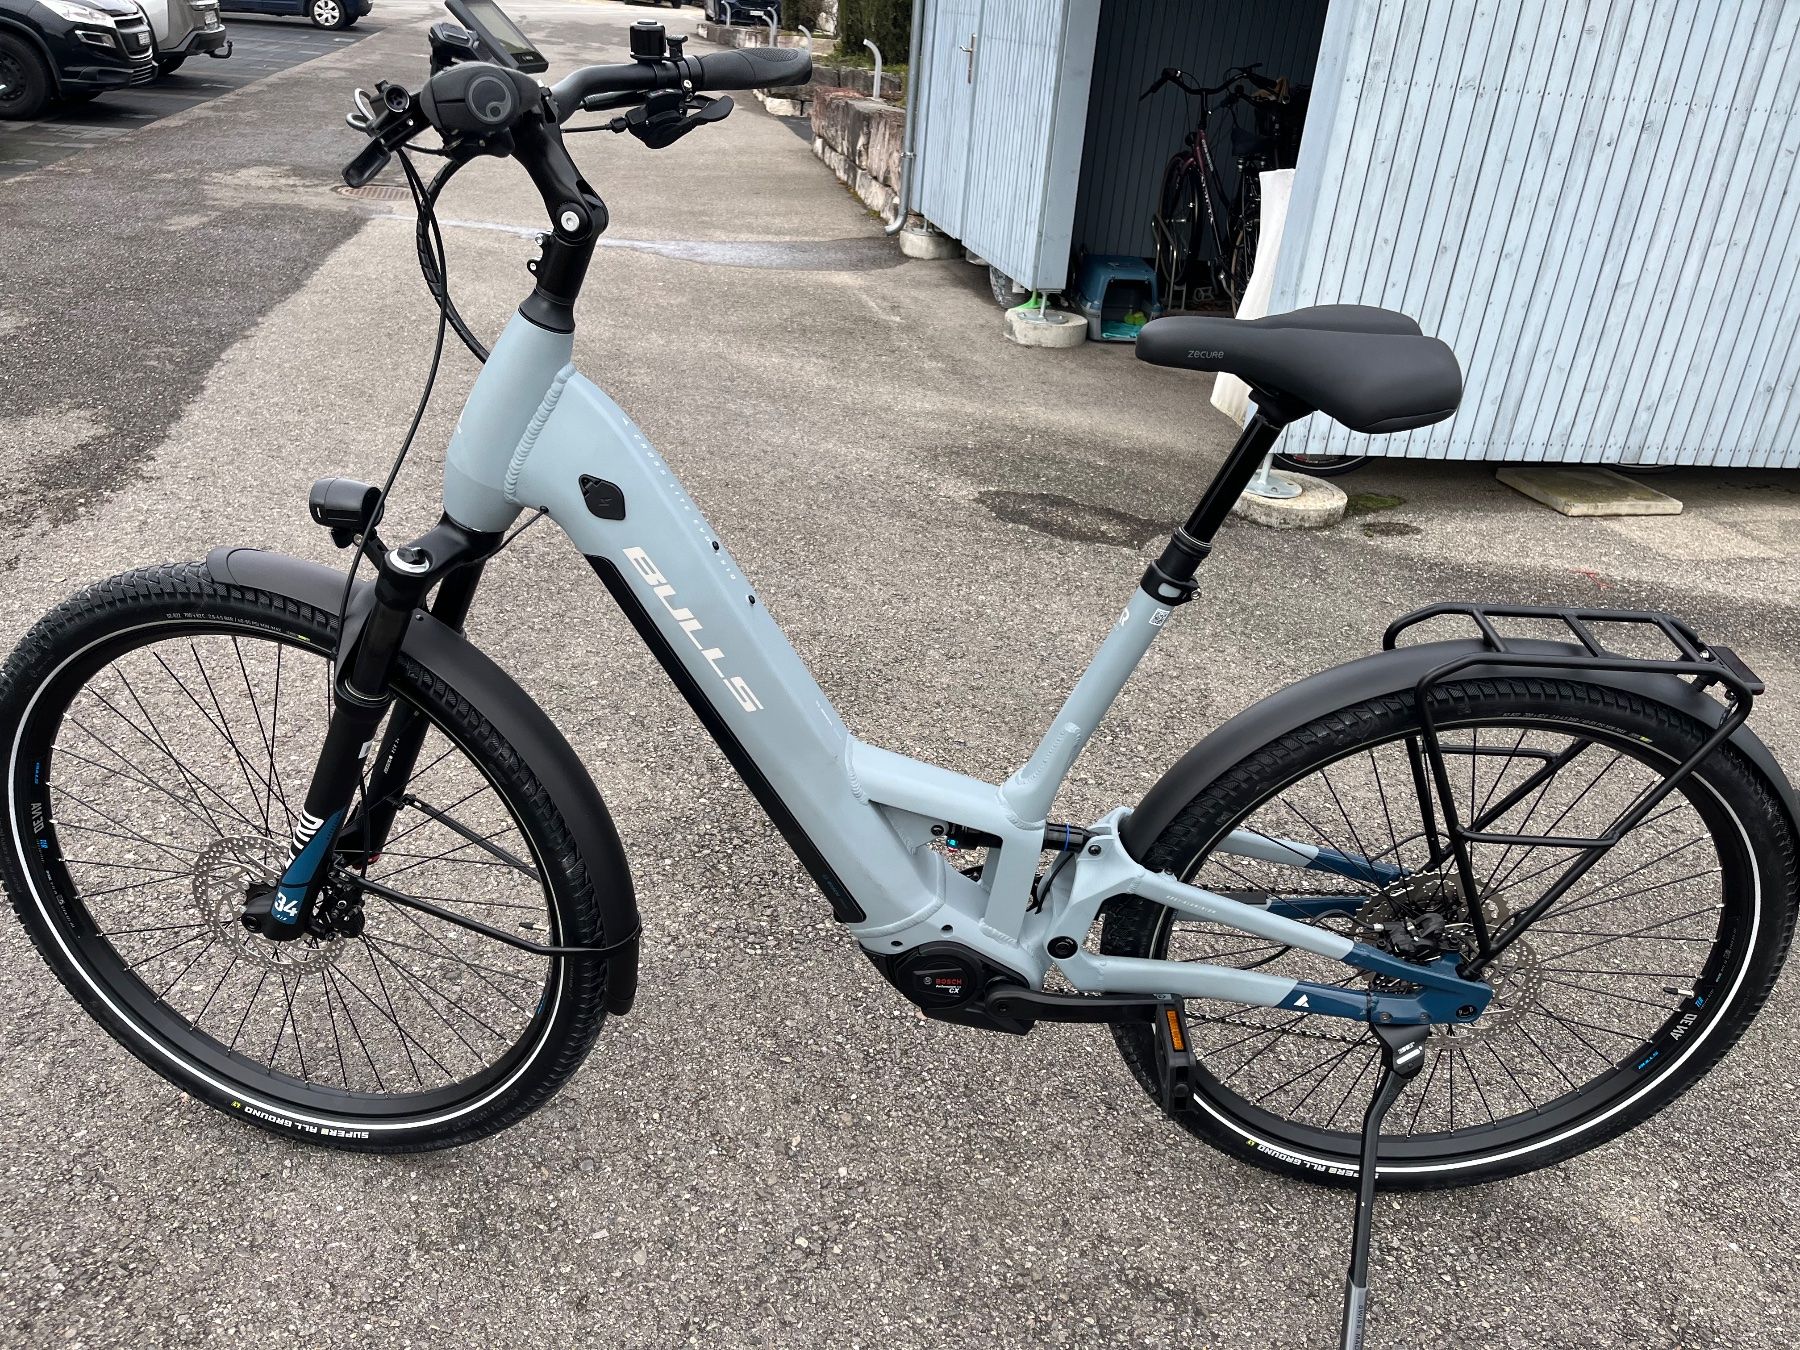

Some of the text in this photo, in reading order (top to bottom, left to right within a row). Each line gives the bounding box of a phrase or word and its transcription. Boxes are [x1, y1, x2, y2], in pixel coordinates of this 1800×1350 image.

[622, 546, 765, 713] BULLS
[275, 891, 299, 917] 34
[244, 1106, 293, 1128] GROUND
[294, 1122, 318, 1134] ALL
[1256, 1144, 1302, 1166] GROUND
[1303, 1160, 1327, 1172] ALL
